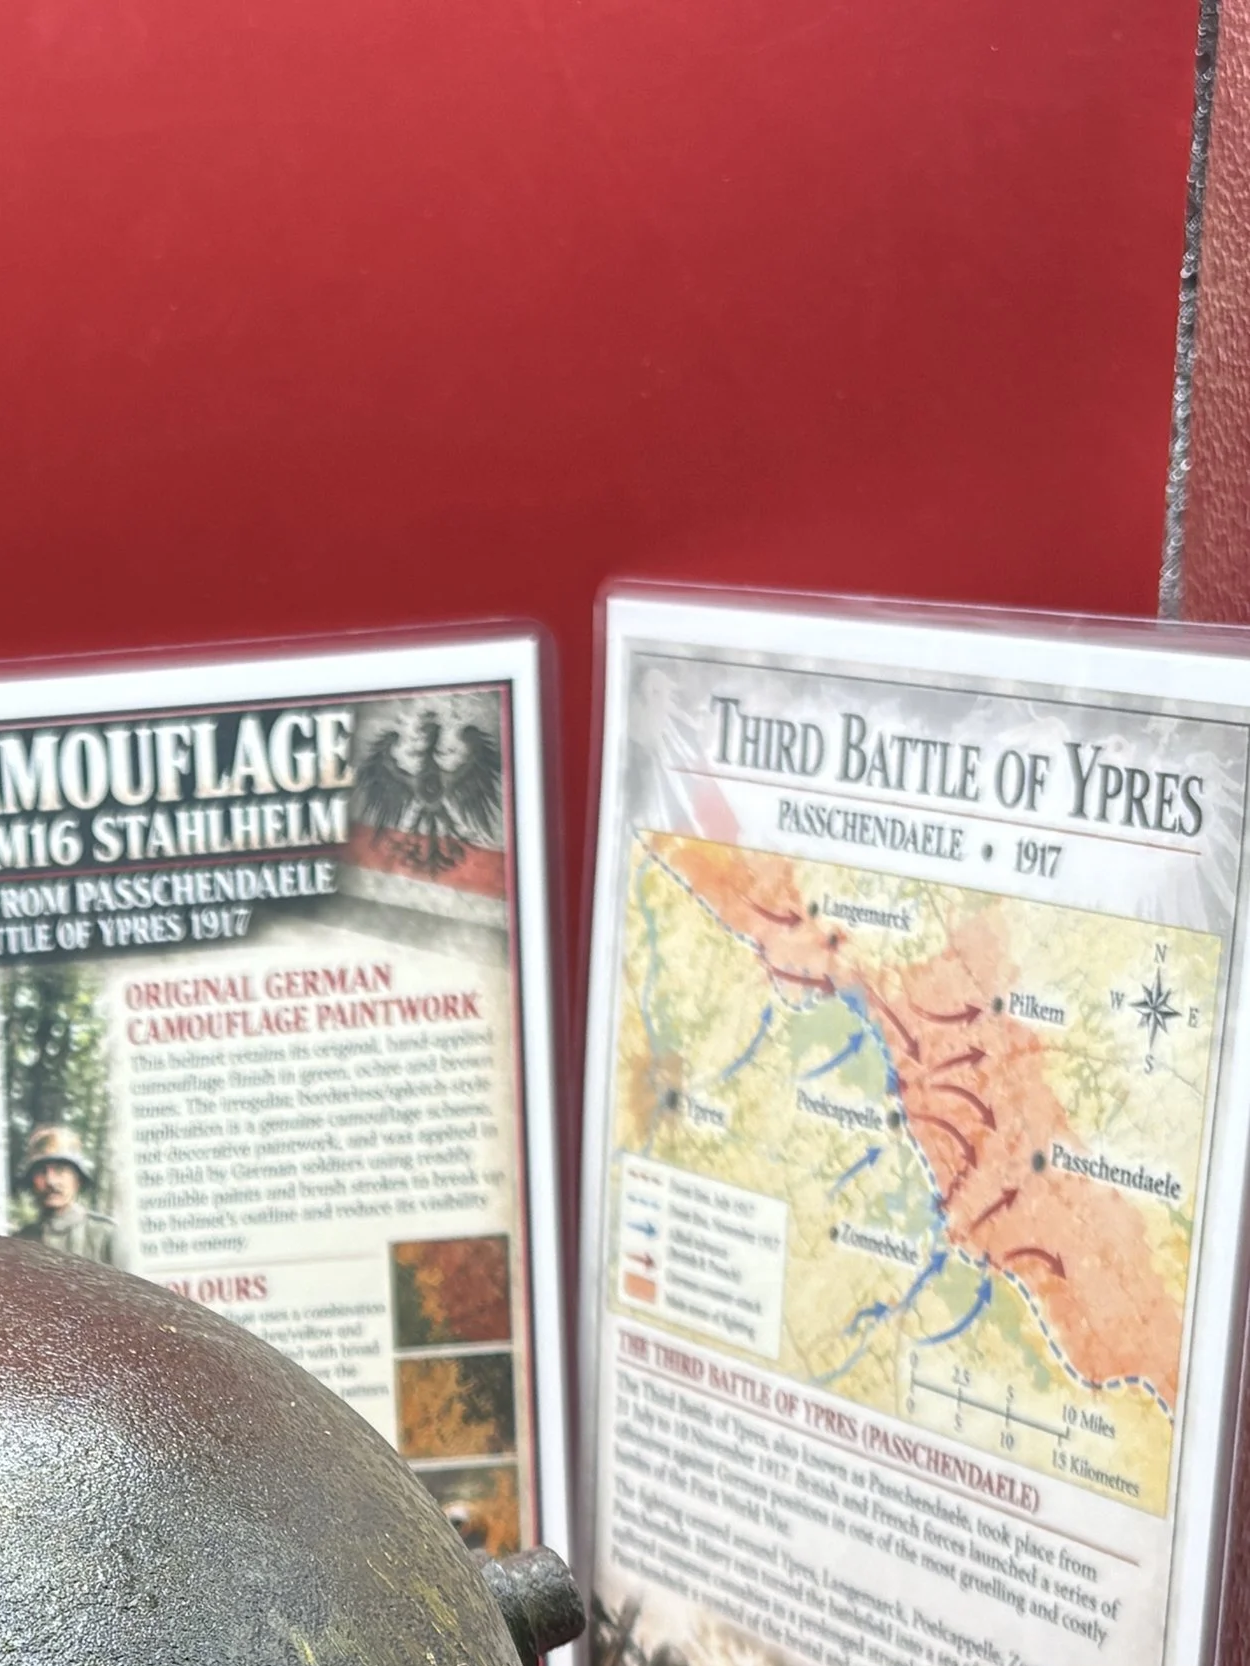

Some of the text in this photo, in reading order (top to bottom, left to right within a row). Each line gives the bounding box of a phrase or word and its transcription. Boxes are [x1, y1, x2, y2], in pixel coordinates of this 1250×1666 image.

[707, 694, 827, 780] THIRD
[835, 712, 983, 804] BATTLE
[1060, 740, 1207, 839] YPRES
[90, 795, 350, 863] STAHLHELM
[777, 797, 1063, 880] PASSCHENDAELE 1917
[73, 858, 338, 913] PASSCHENDAELE
[823, 893, 912, 932] Langemarck
[56, 918, 92, 949] OF
[98, 911, 183, 947] YPRES
[188, 906, 253, 939] 1917
[1153, 943, 1168, 964] N
[124, 961, 393, 1012] ORIGINAL GERMAN
[1010, 992, 1066, 1025] Pilkem
[1110, 990, 1125, 1011] W
[125, 991, 480, 1047] CAMOUFLAGE PAINTWORK
[1187, 1007, 1200, 1028] E
[1051, 1143, 1182, 1200] Passchendaele
[841, 1222, 919, 1266] Zonnebeke
[166, 1275, 268, 1301] OLOURS
[1063, 1404, 1078, 1425] 10
[1080, 1412, 1116, 1439] Miles
[773, 1388, 798, 1420] OF
[801, 1398, 858, 1443] YPRES
[860, 1421, 1041, 1515] (PASSCHENDAELE)
[1000, 1433, 1015, 1450] 10
[1052, 1450, 1066, 1469] 15
[1070, 1455, 1140, 1498] Kilometres
[923, 1519, 965, 1557] forces
[969, 1538, 1036, 1587] launched
[1040, 1576, 1049, 1592] a
[1054, 1581, 1096, 1612] series
[1101, 1597, 1121, 1622] of
[976, 1513, 1011, 1547] took
[1014, 1531, 1054, 1565] place
[1058, 1546, 1097, 1583] from
[959, 1570, 1025, 1617] gruelling
[1029, 1599, 1058, 1624] and
[1062, 1613, 1108, 1652] costly
